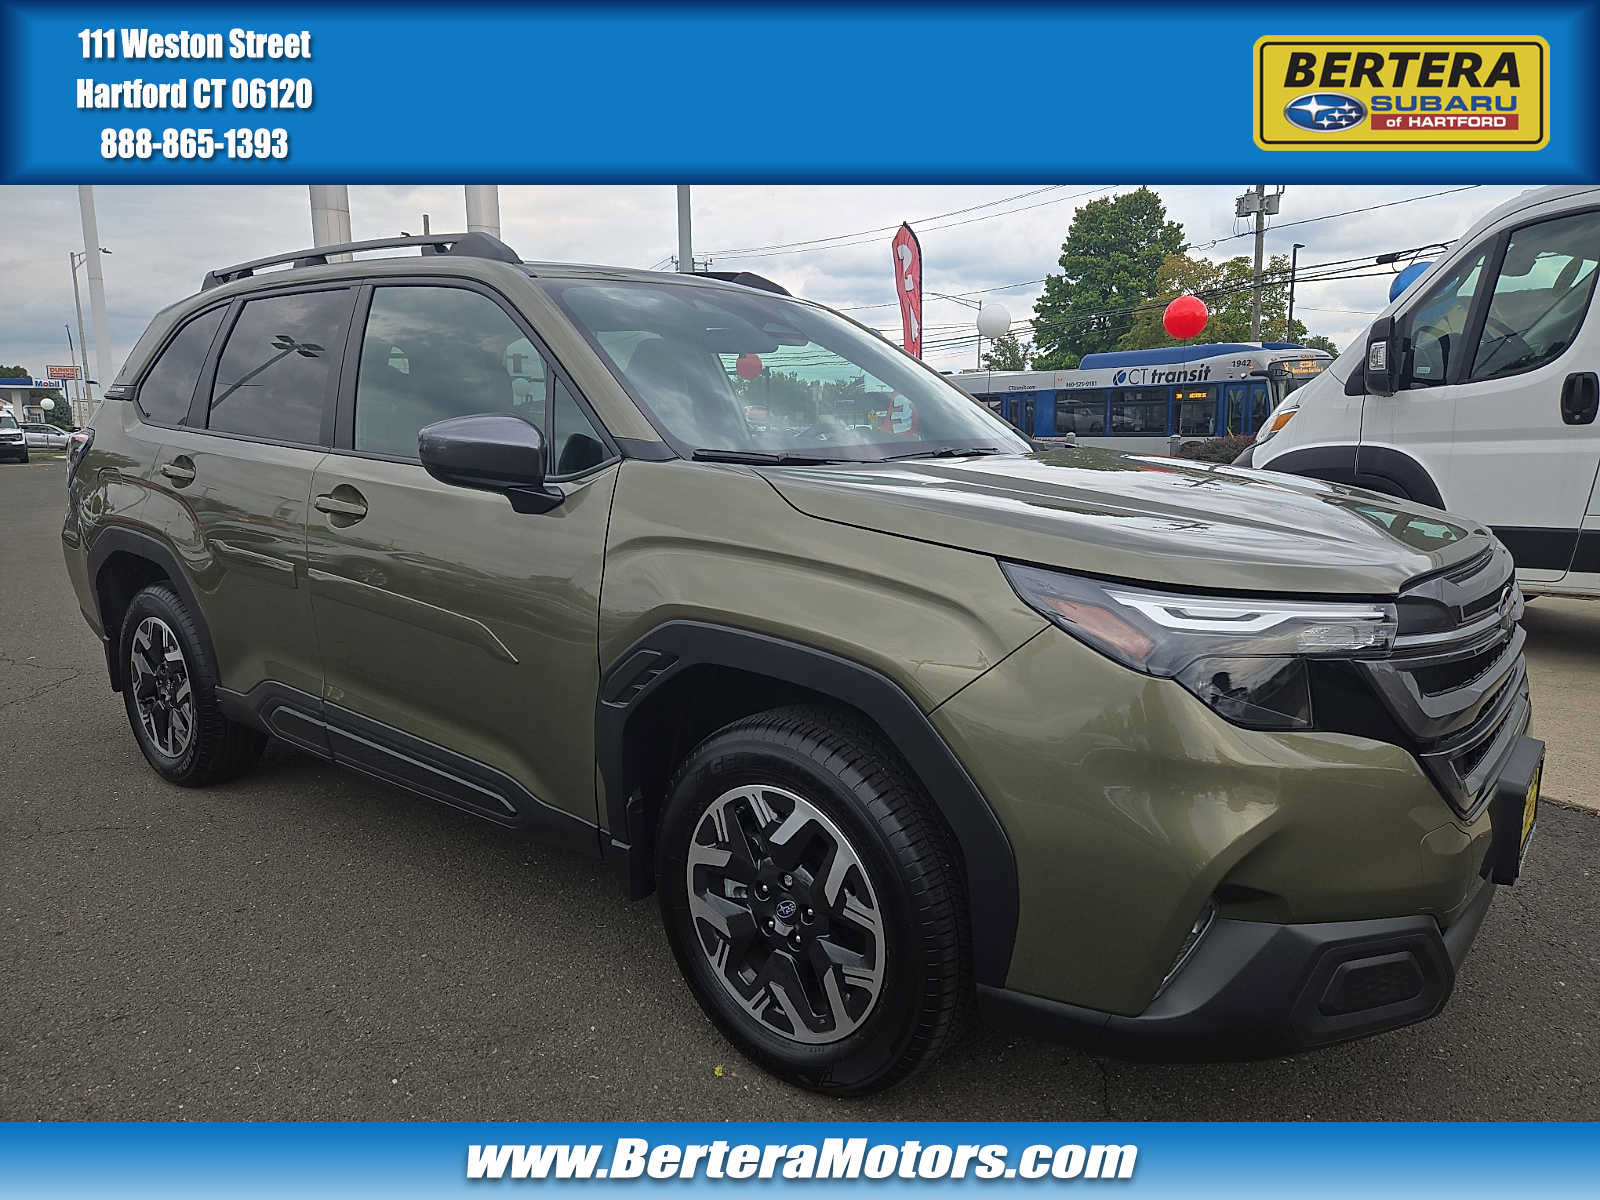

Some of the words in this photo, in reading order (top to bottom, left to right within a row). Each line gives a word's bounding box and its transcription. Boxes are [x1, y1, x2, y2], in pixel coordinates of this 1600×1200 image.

[1231, 359, 1252, 368] 1942
[1128, 368, 1149, 385] CT
[1151, 363, 1212, 384] transit
[34, 380, 60, 388] Mobil
